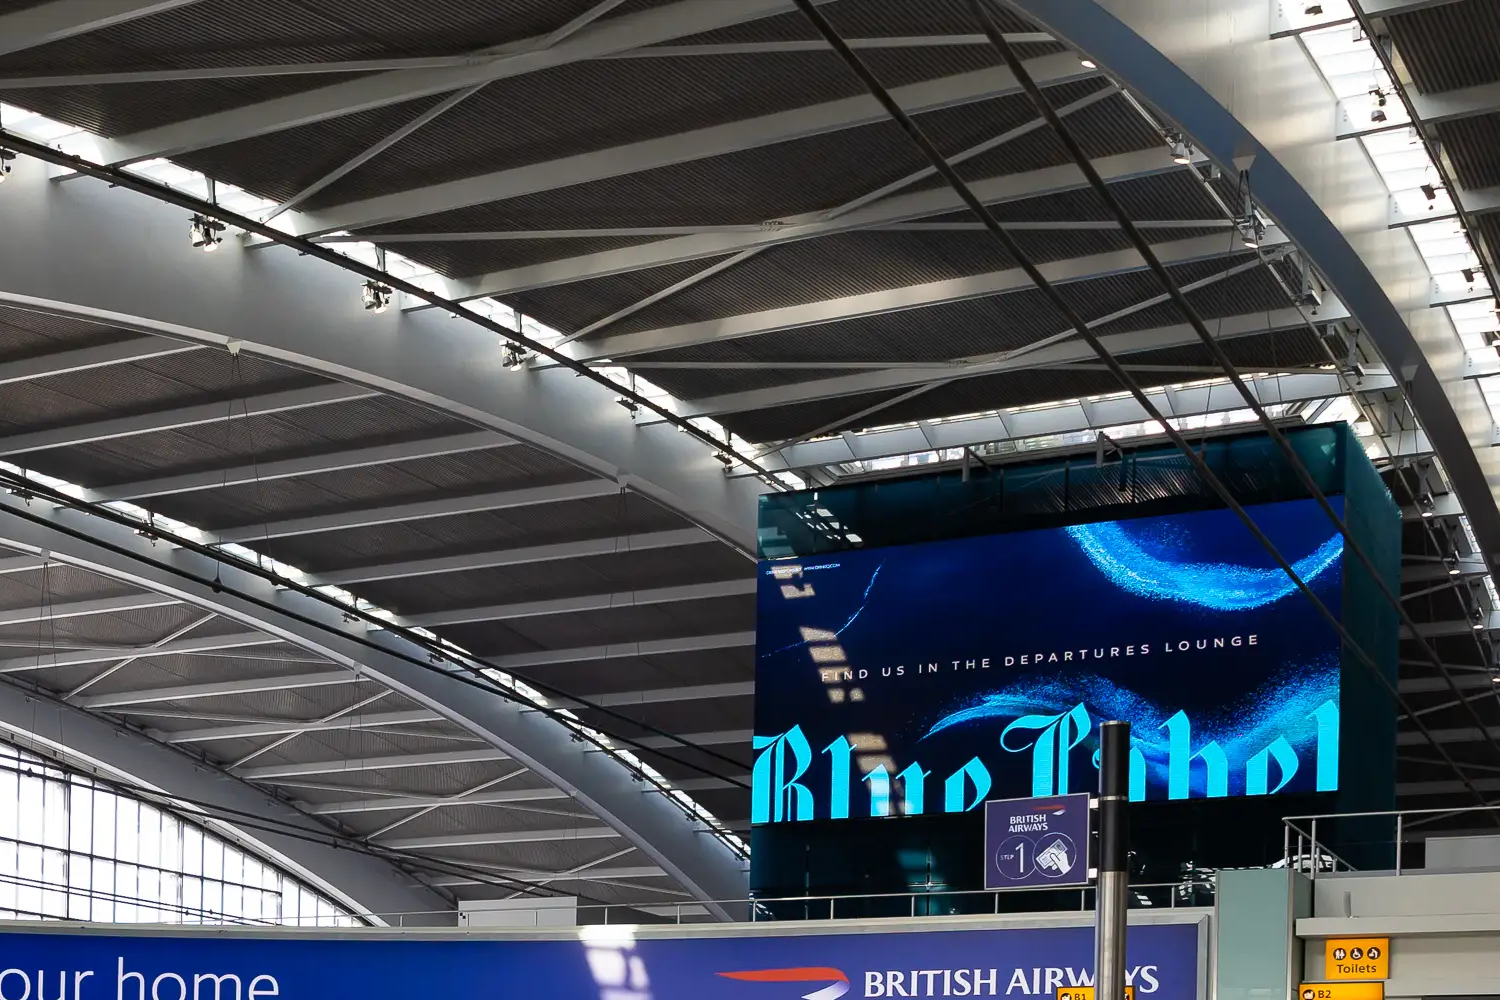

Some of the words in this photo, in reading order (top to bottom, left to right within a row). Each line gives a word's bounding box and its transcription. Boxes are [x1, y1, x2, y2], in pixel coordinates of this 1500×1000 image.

[821, 669, 869, 682] FIND
[881, 665, 906, 677] US
[918, 662, 939, 674] IN
[952, 657, 992, 670] THE
[1004, 644, 1151, 667] DEPARTURES
[1165, 634, 1260, 653] LOUNGE
[1009, 814, 1047, 824] BRITISH
[1008, 822, 1048, 833] AIRWAYS
[1015, 842, 1024, 873] 1
[1336, 964, 1377, 974] Toilets
[863, 968, 997, 998] BRITISH
[1005, 965, 1159, 996] AIRWYS
[1318, 990, 1331, 999] B2
